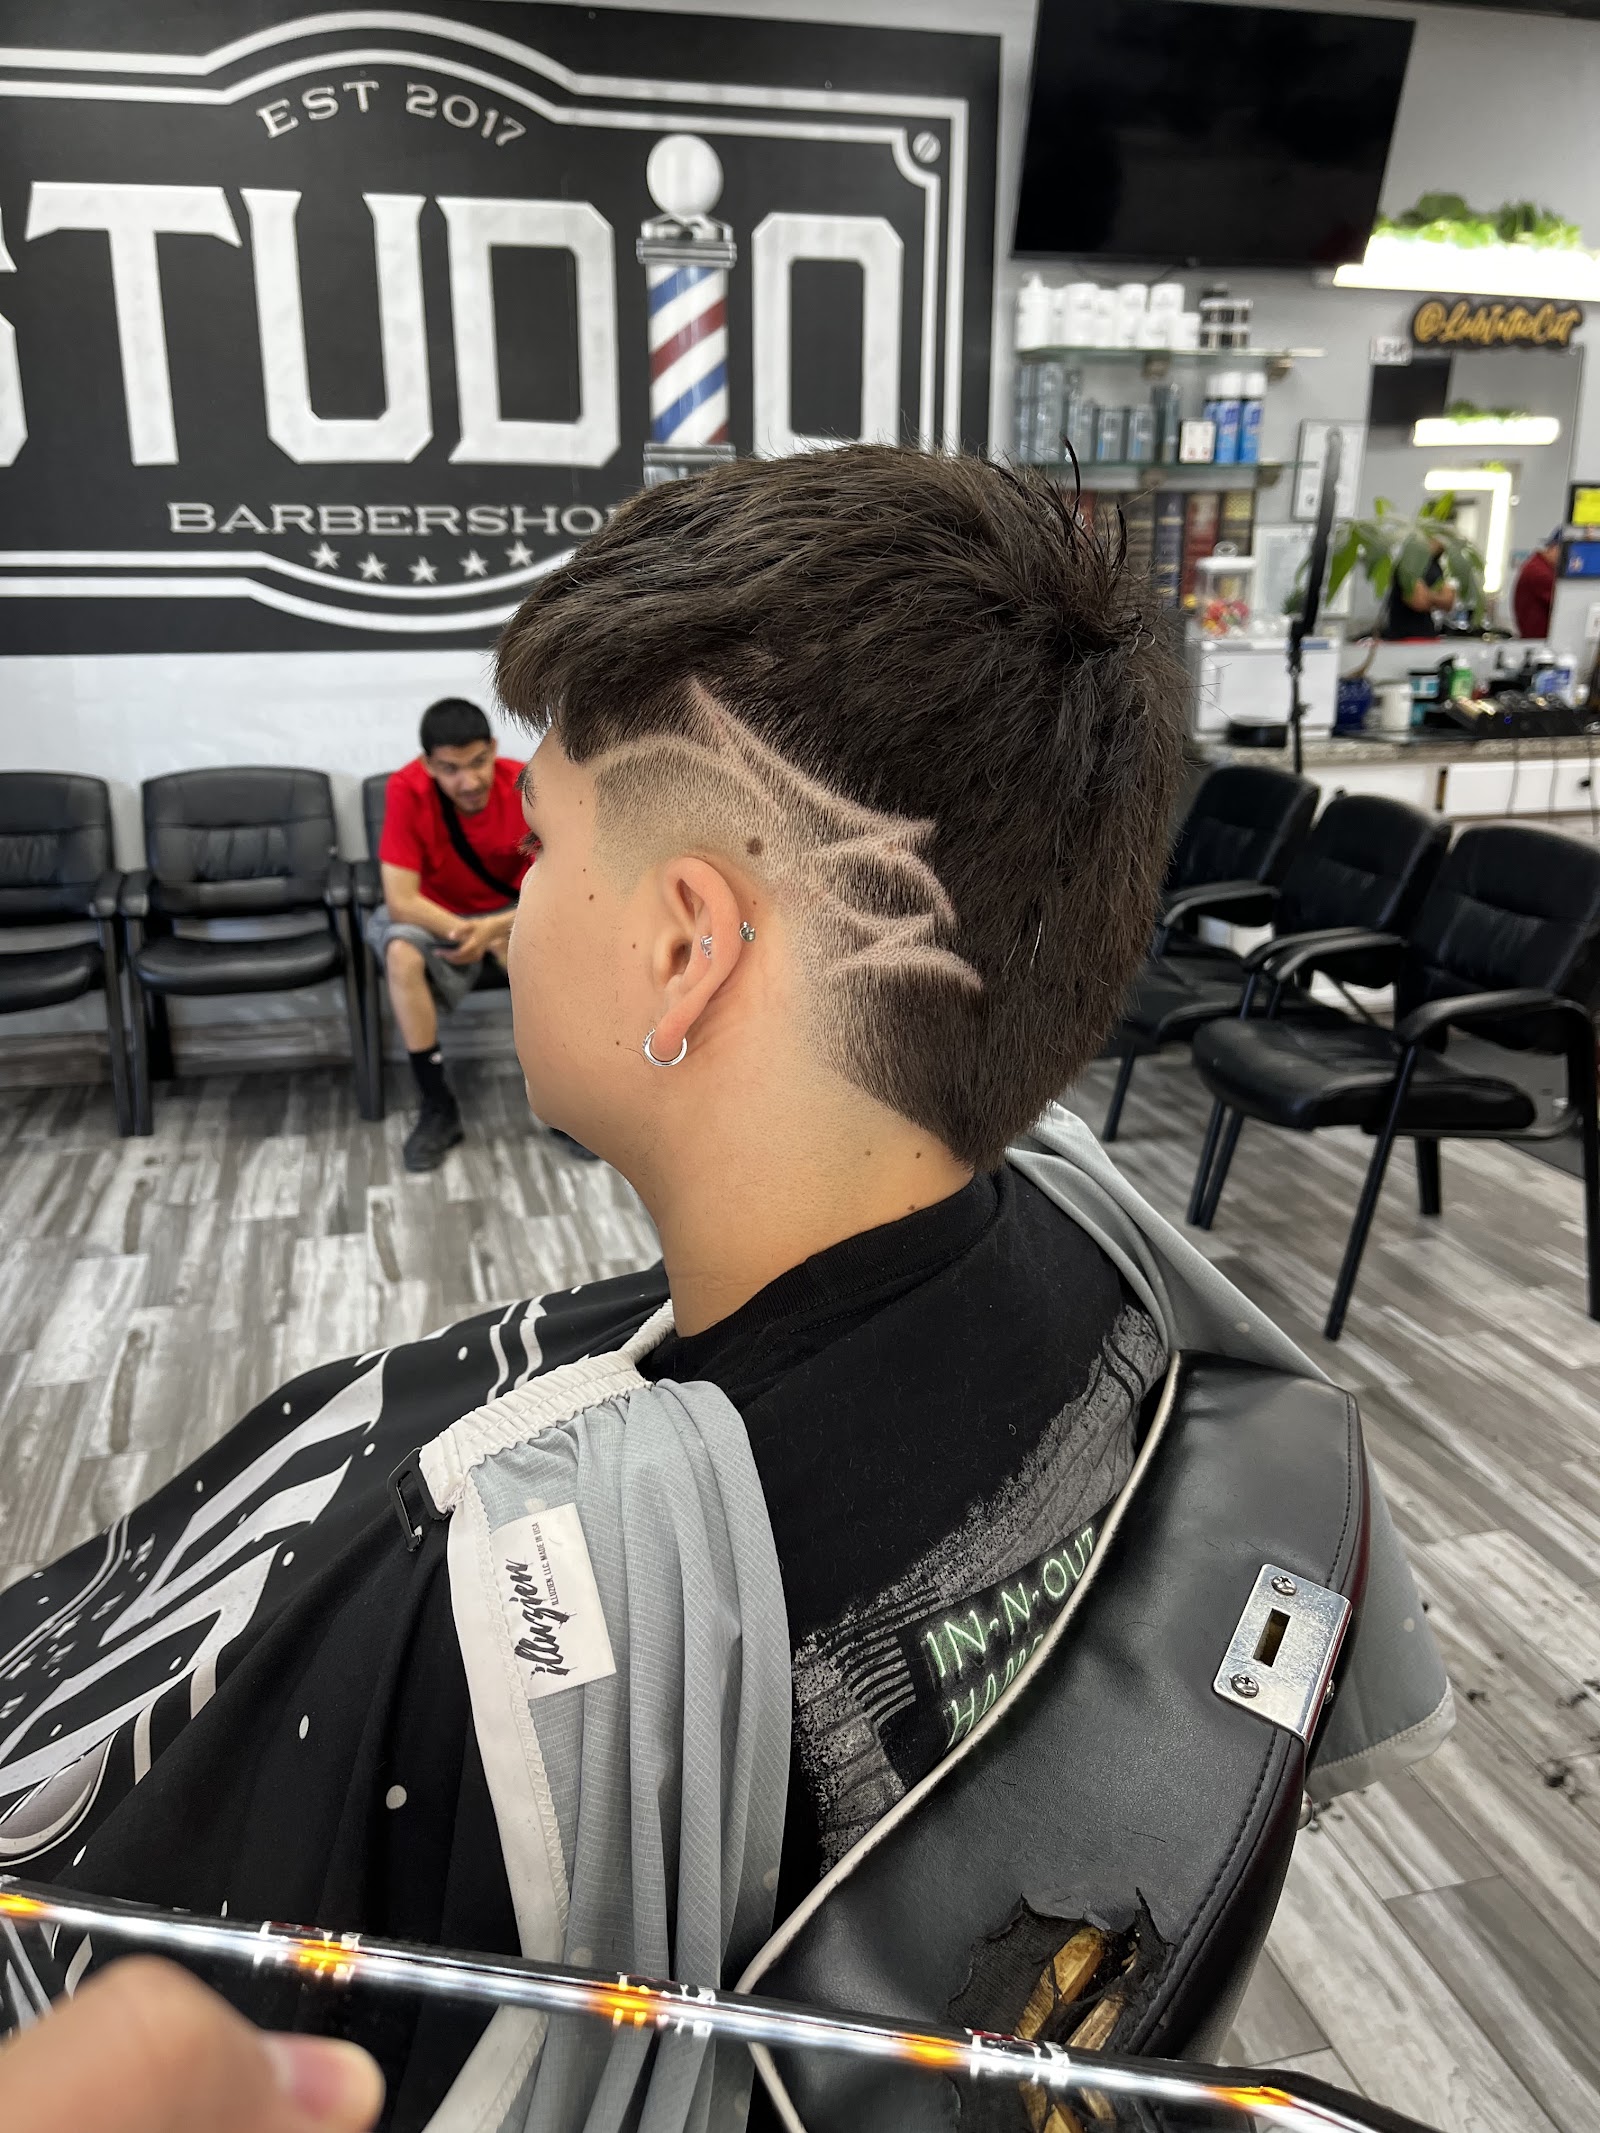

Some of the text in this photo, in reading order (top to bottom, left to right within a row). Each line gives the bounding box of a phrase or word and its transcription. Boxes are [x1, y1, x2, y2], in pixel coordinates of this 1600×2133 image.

[256, 80, 526, 146] EST 2017
[0, 135, 904, 485] TUDIO
[168, 502, 616, 536] BARBERSHO
[532, 1522, 541, 1535] USA
[536, 1542, 548, 1561] MADE
